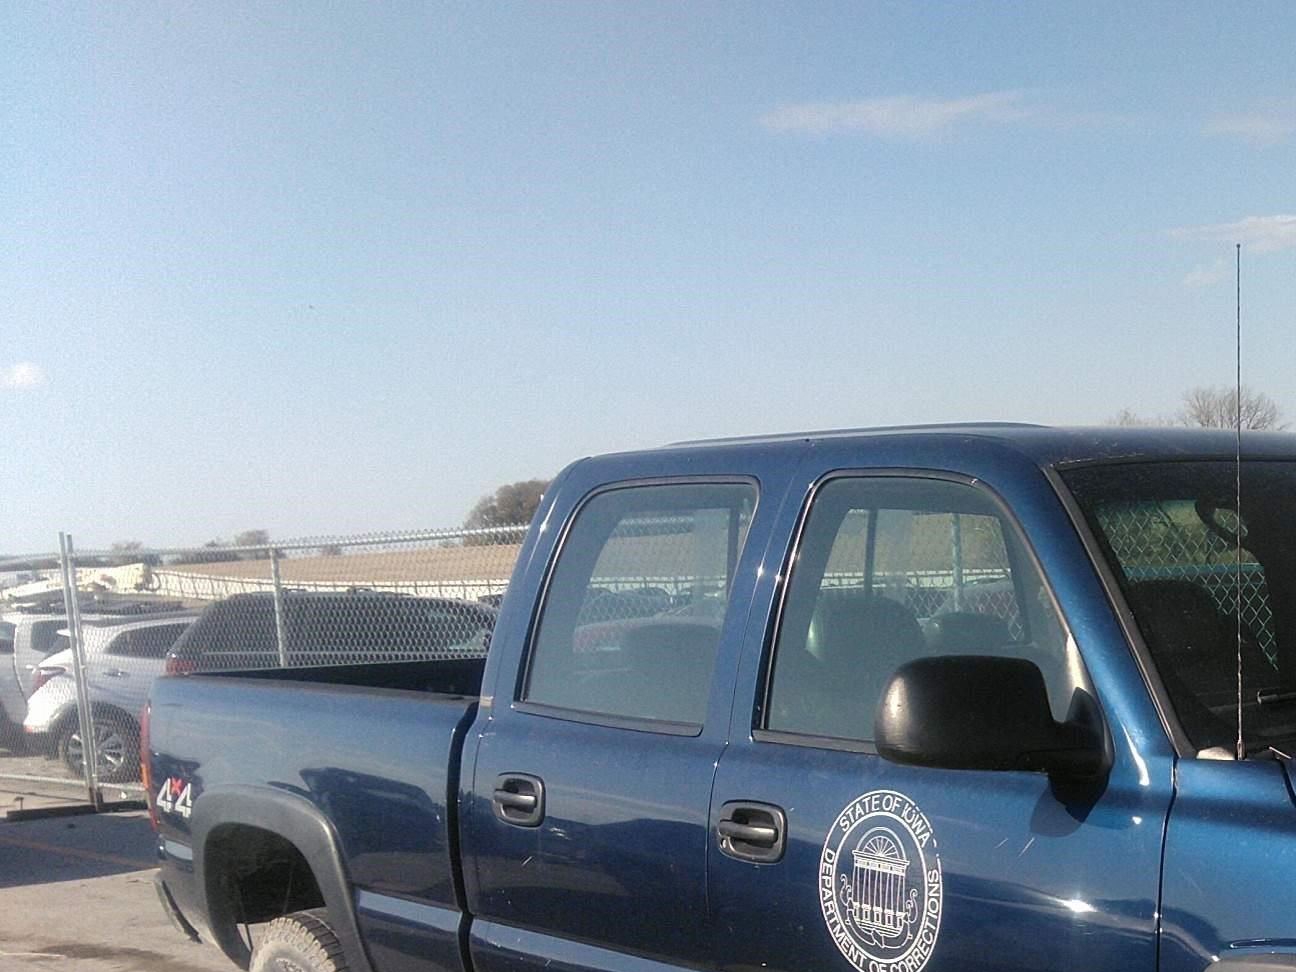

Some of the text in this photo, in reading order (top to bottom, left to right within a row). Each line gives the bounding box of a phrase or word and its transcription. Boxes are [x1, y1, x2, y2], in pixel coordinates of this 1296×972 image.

[839, 795, 931, 848] STATE OF IOWA
[820, 848, 868, 969] DEPARTMENT
